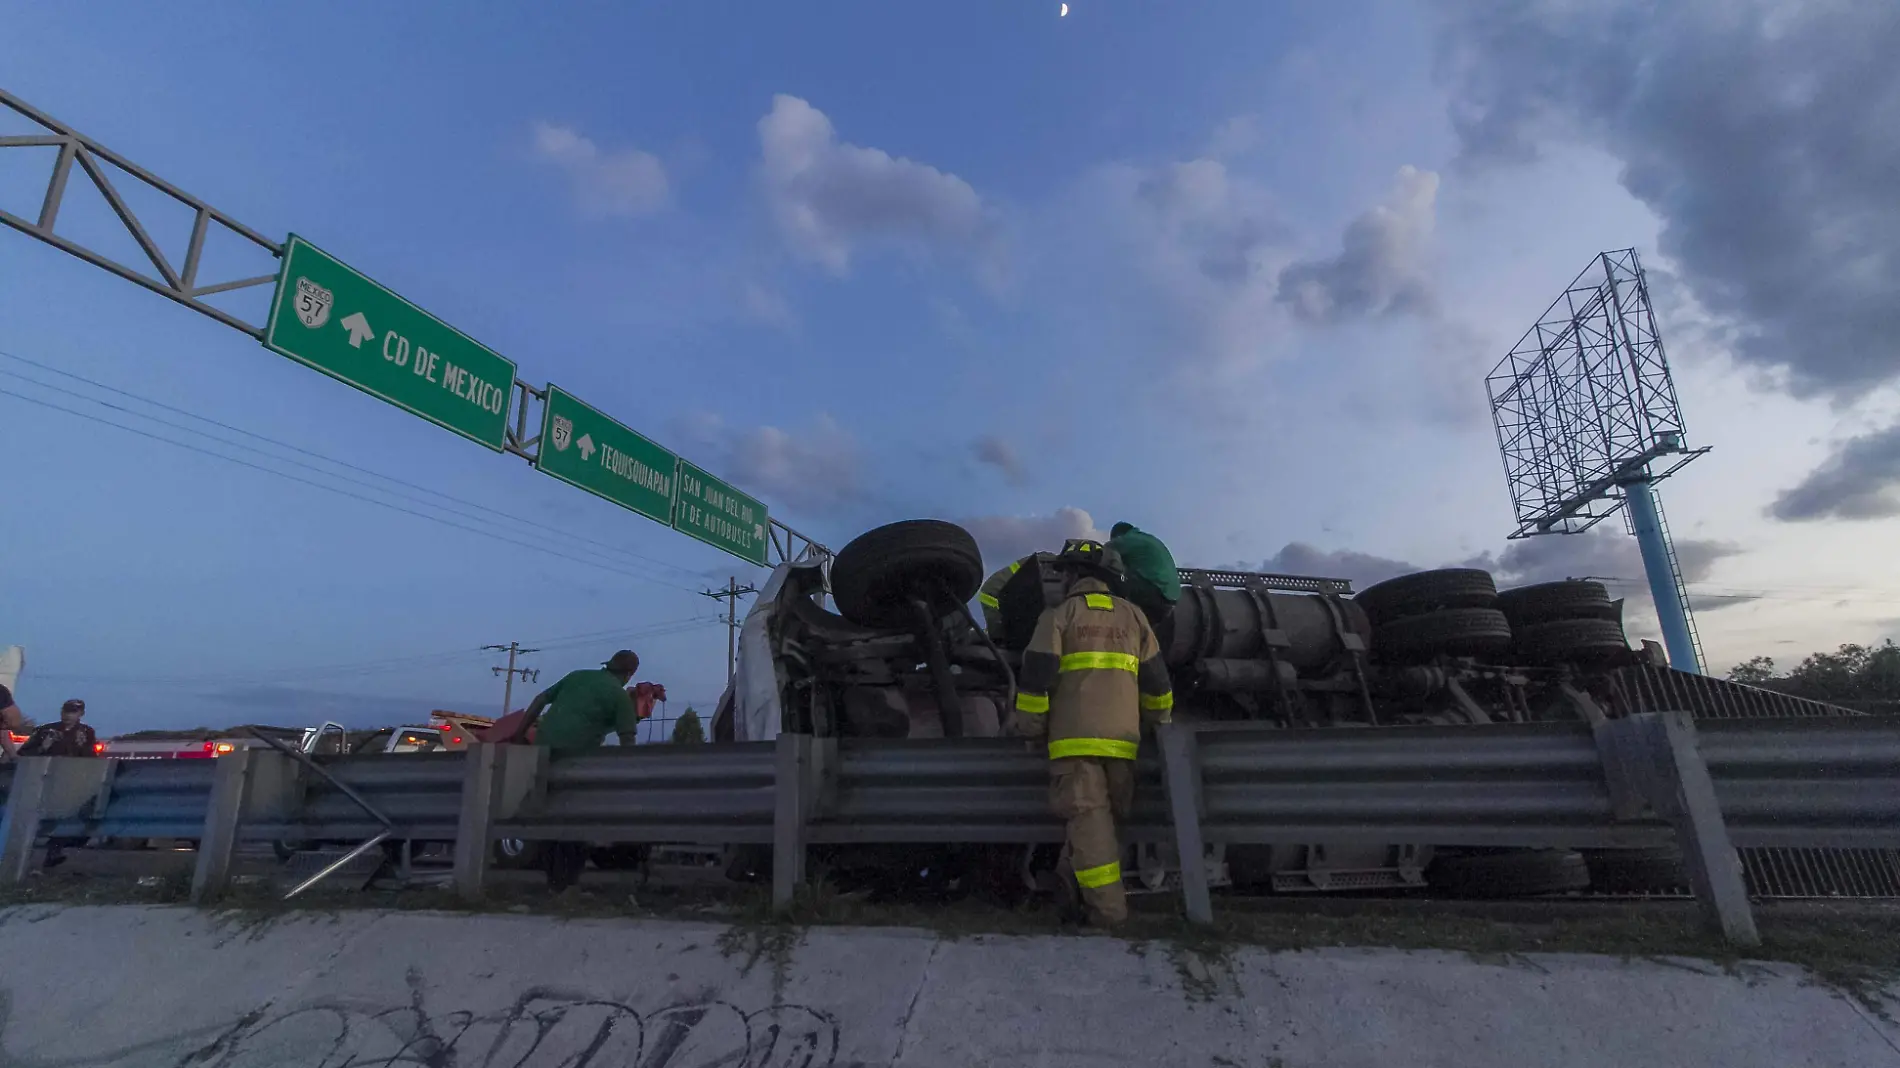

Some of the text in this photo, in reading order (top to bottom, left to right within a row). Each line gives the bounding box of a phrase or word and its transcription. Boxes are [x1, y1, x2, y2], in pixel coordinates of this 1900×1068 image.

[299, 280, 331, 302] MEXICO
[300, 294, 324, 317] 57
[306, 315, 313, 325] D
[383, 330, 503, 415] CD DE MEXICO
[555, 427, 568, 443] 57
[600, 443, 671, 498] TEQUISQUIAPAN
[683, 474, 753, 525] SAN JUAN DEL RIO
[680, 500, 752, 549] T DE AUTOBUSES
